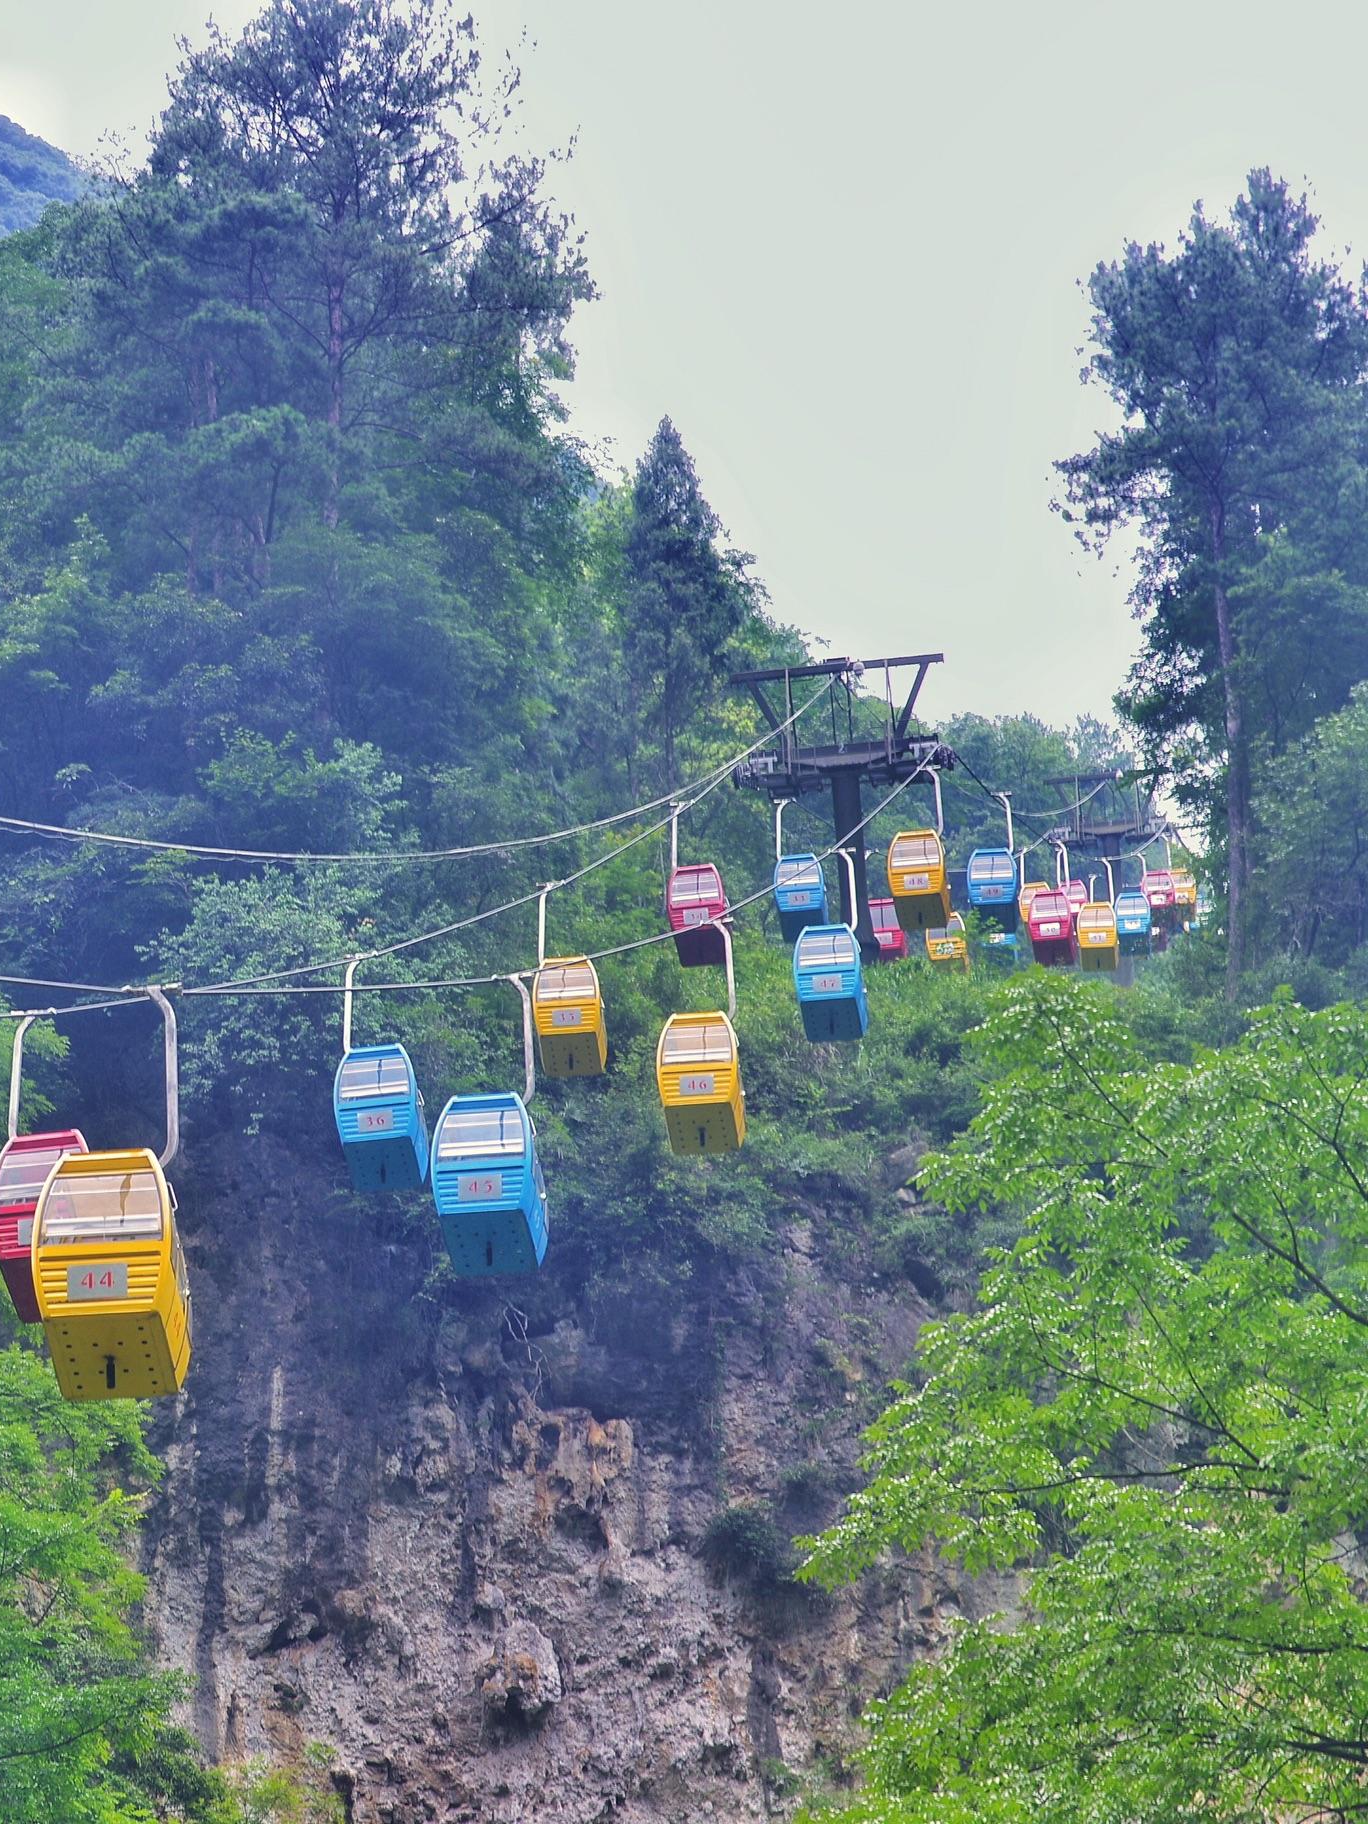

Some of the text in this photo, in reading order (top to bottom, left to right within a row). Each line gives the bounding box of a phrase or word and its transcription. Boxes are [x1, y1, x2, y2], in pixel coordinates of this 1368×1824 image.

[687, 1079, 708, 1091] 46
[366, 1116, 386, 1128] 36
[468, 1180, 493, 1194] 45
[80, 1271, 116, 1289] 44
